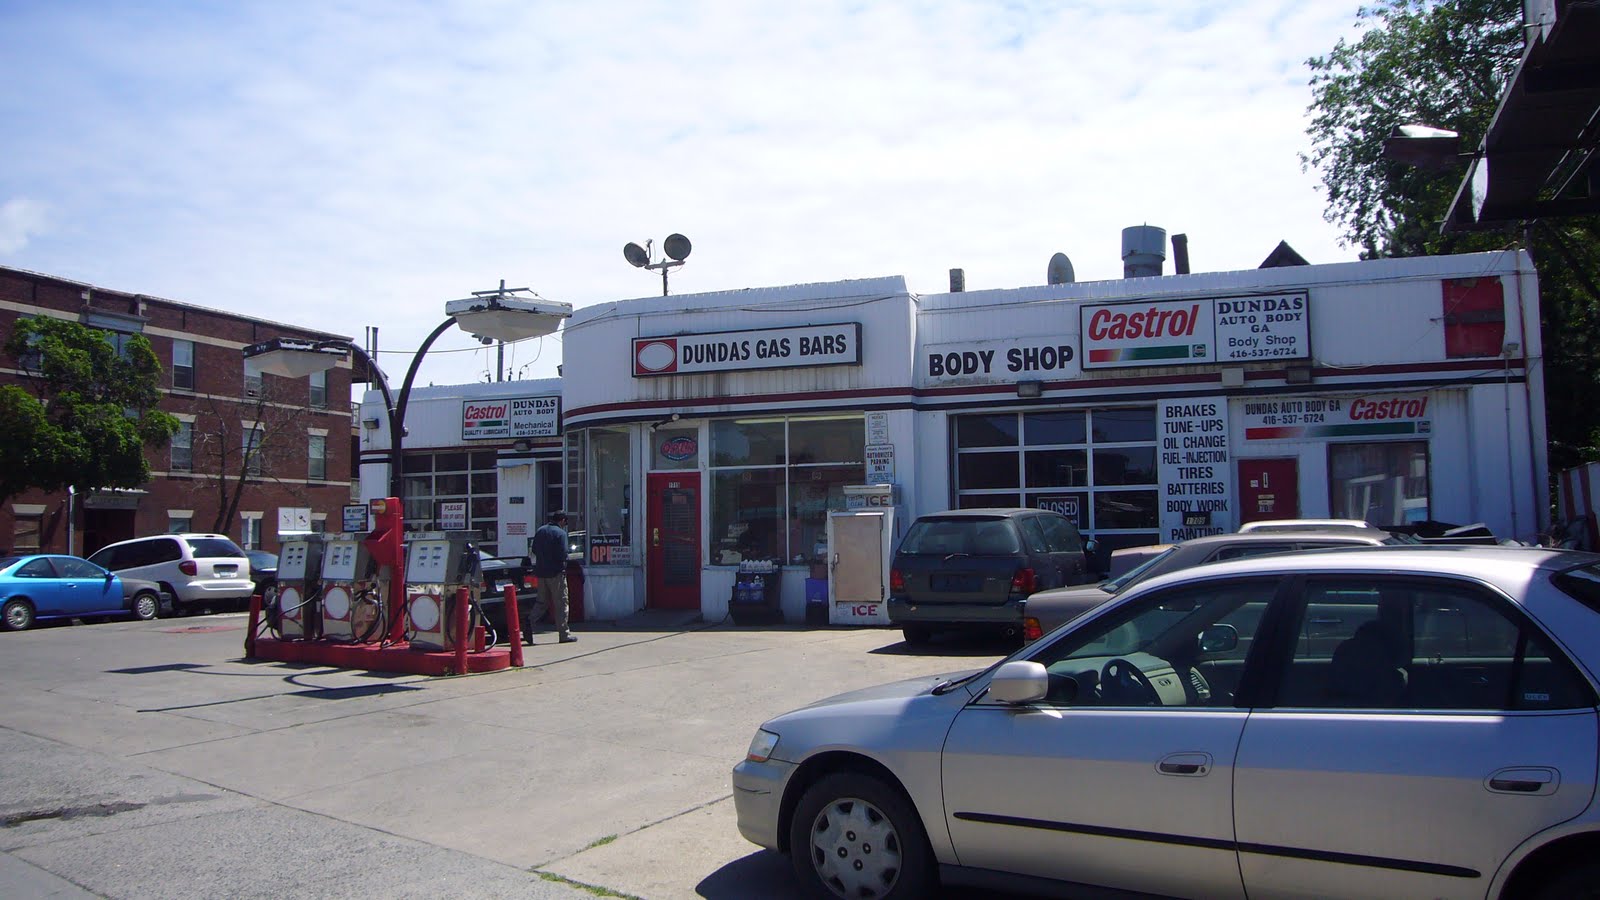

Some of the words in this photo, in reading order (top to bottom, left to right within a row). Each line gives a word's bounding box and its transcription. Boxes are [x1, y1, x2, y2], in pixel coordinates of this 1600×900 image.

[1218, 298, 1303, 314] DUNDAS
[1089, 305, 1199, 340] Castrol
[1220, 315, 1257, 325] AUTO
[1266, 312, 1302, 322] BODY
[1251, 324, 1270, 333] GA
[1228, 337, 1259, 348] Body
[1266, 335, 1296, 345] Shop
[683, 341, 750, 364] DUNDAS
[756, 338, 791, 358] GAS
[799, 334, 847, 356] BARS
[1230, 348, 1297, 358] 416-537-6724
[929, 350, 994, 376] BODY
[1007, 346, 1074, 372] SHOP
[513, 400, 555, 409] DUNDAS
[1166, 404, 1216, 418] BRAKES
[1246, 403, 1278, 415] DUNDAS
[1281, 401, 1302, 413] AUTO
[1305, 400, 1326, 412] BODY
[1329, 400, 1340, 411] GA
[1350, 397, 1427, 420] Castrol
[465, 404, 507, 419] Castrol
[514, 421, 553, 429] Mechanical
[1263, 414, 1324, 424] 416-537-6724
[1164, 419, 1223, 433] TUNE-UPS
[1163, 438, 1179, 449] OIL
[1184, 435, 1226, 448] CHANGE
[1163, 451, 1227, 464] FUEL-INJECTION
[1177, 466, 1213, 479] TIRES
[1167, 482, 1224, 495] BATTERIES
[865, 495, 889, 507] ICE
[1167, 500, 1192, 512] BODY
[1197, 500, 1228, 512] WORK
[852, 604, 878, 616] ICE
